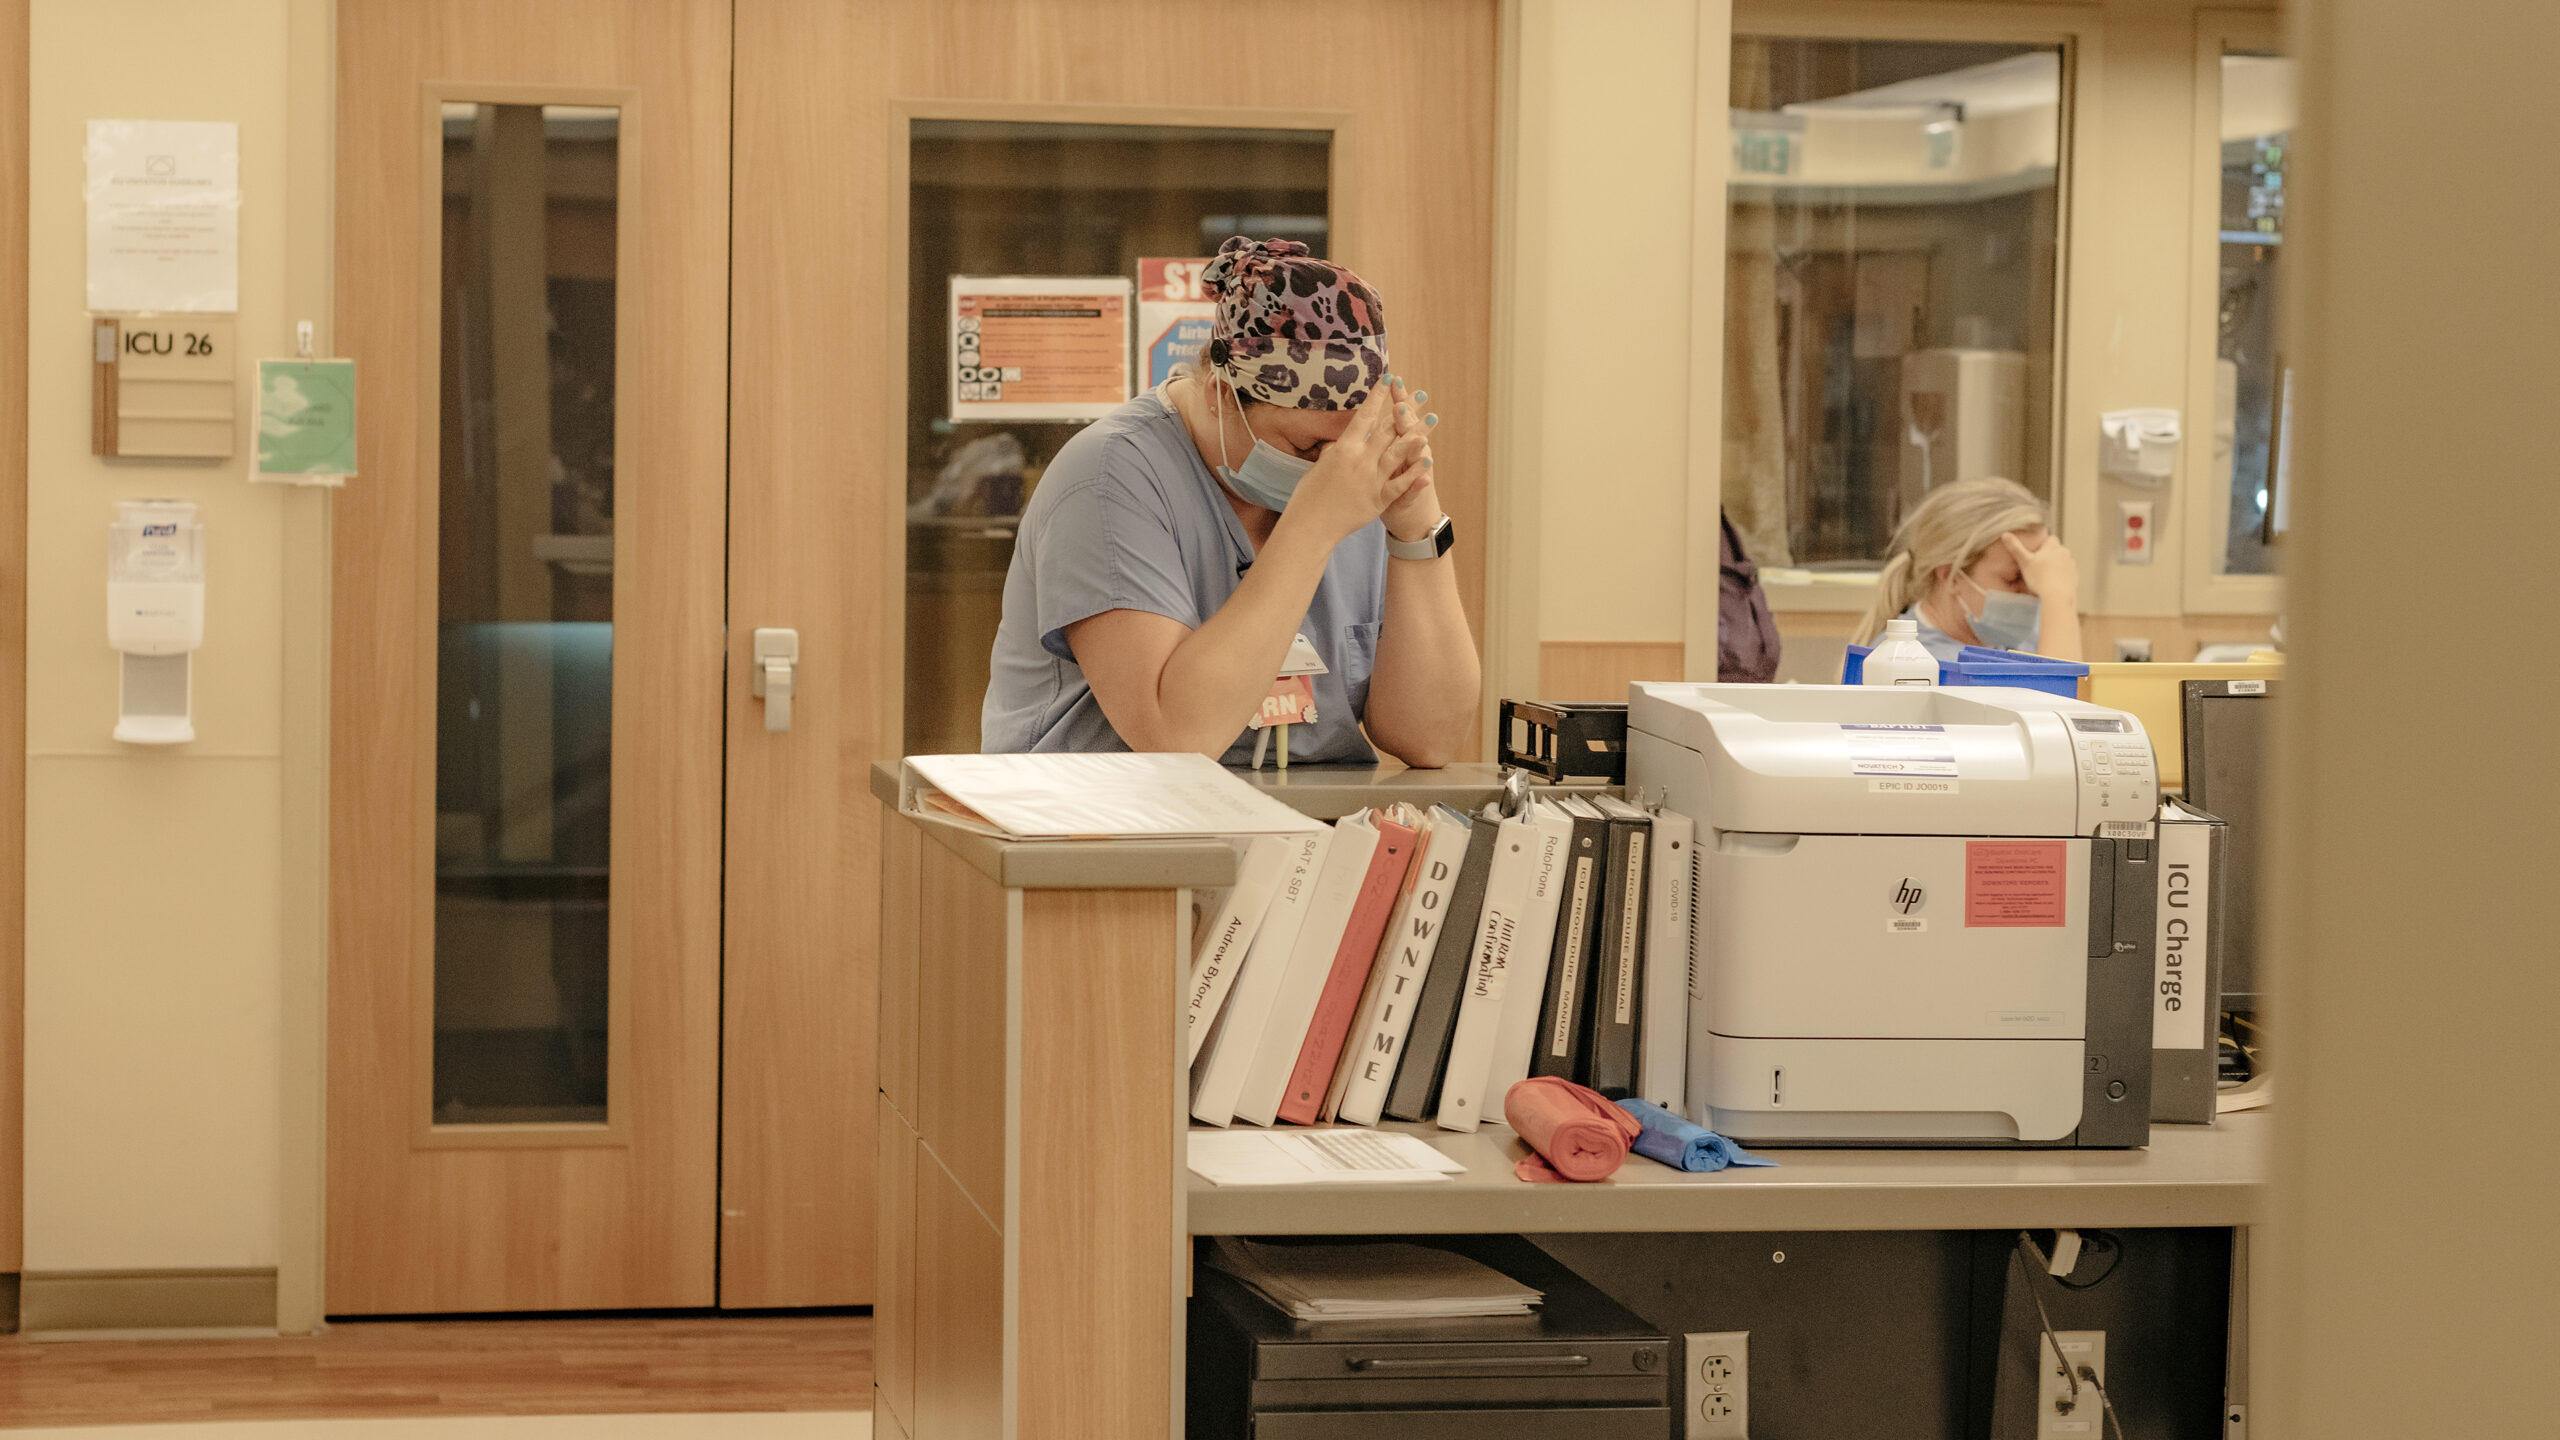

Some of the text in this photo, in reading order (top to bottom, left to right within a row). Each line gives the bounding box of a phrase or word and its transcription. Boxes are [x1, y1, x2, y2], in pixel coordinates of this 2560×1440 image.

[1164, 262, 1206, 300] ST
[125, 331, 213, 357] ICU 26
[1262, 693, 1298, 718] RN
[1879, 782, 1901, 790] EPIC
[1904, 782, 1913, 791] ID
[1285, 839, 1317, 904] SAT & SBT
[1536, 835, 1559, 898] RotoProne
[1670, 879, 1680, 922] COVID-19
[1895, 877, 1922, 915] hp
[1213, 916, 1243, 964] Andrew
[1618, 841, 1638, 1012] ICU PROCEDURE MANUAL
[2160, 863, 2190, 1012] ICU Charge
[1364, 861, 1449, 1082] DOWNTIME
[1557, 867, 1587, 1046] ICU PROCEDURE MANUAL
[1188, 966, 1219, 1009] Byford,
[2089, 1057, 2099, 1071] 2
